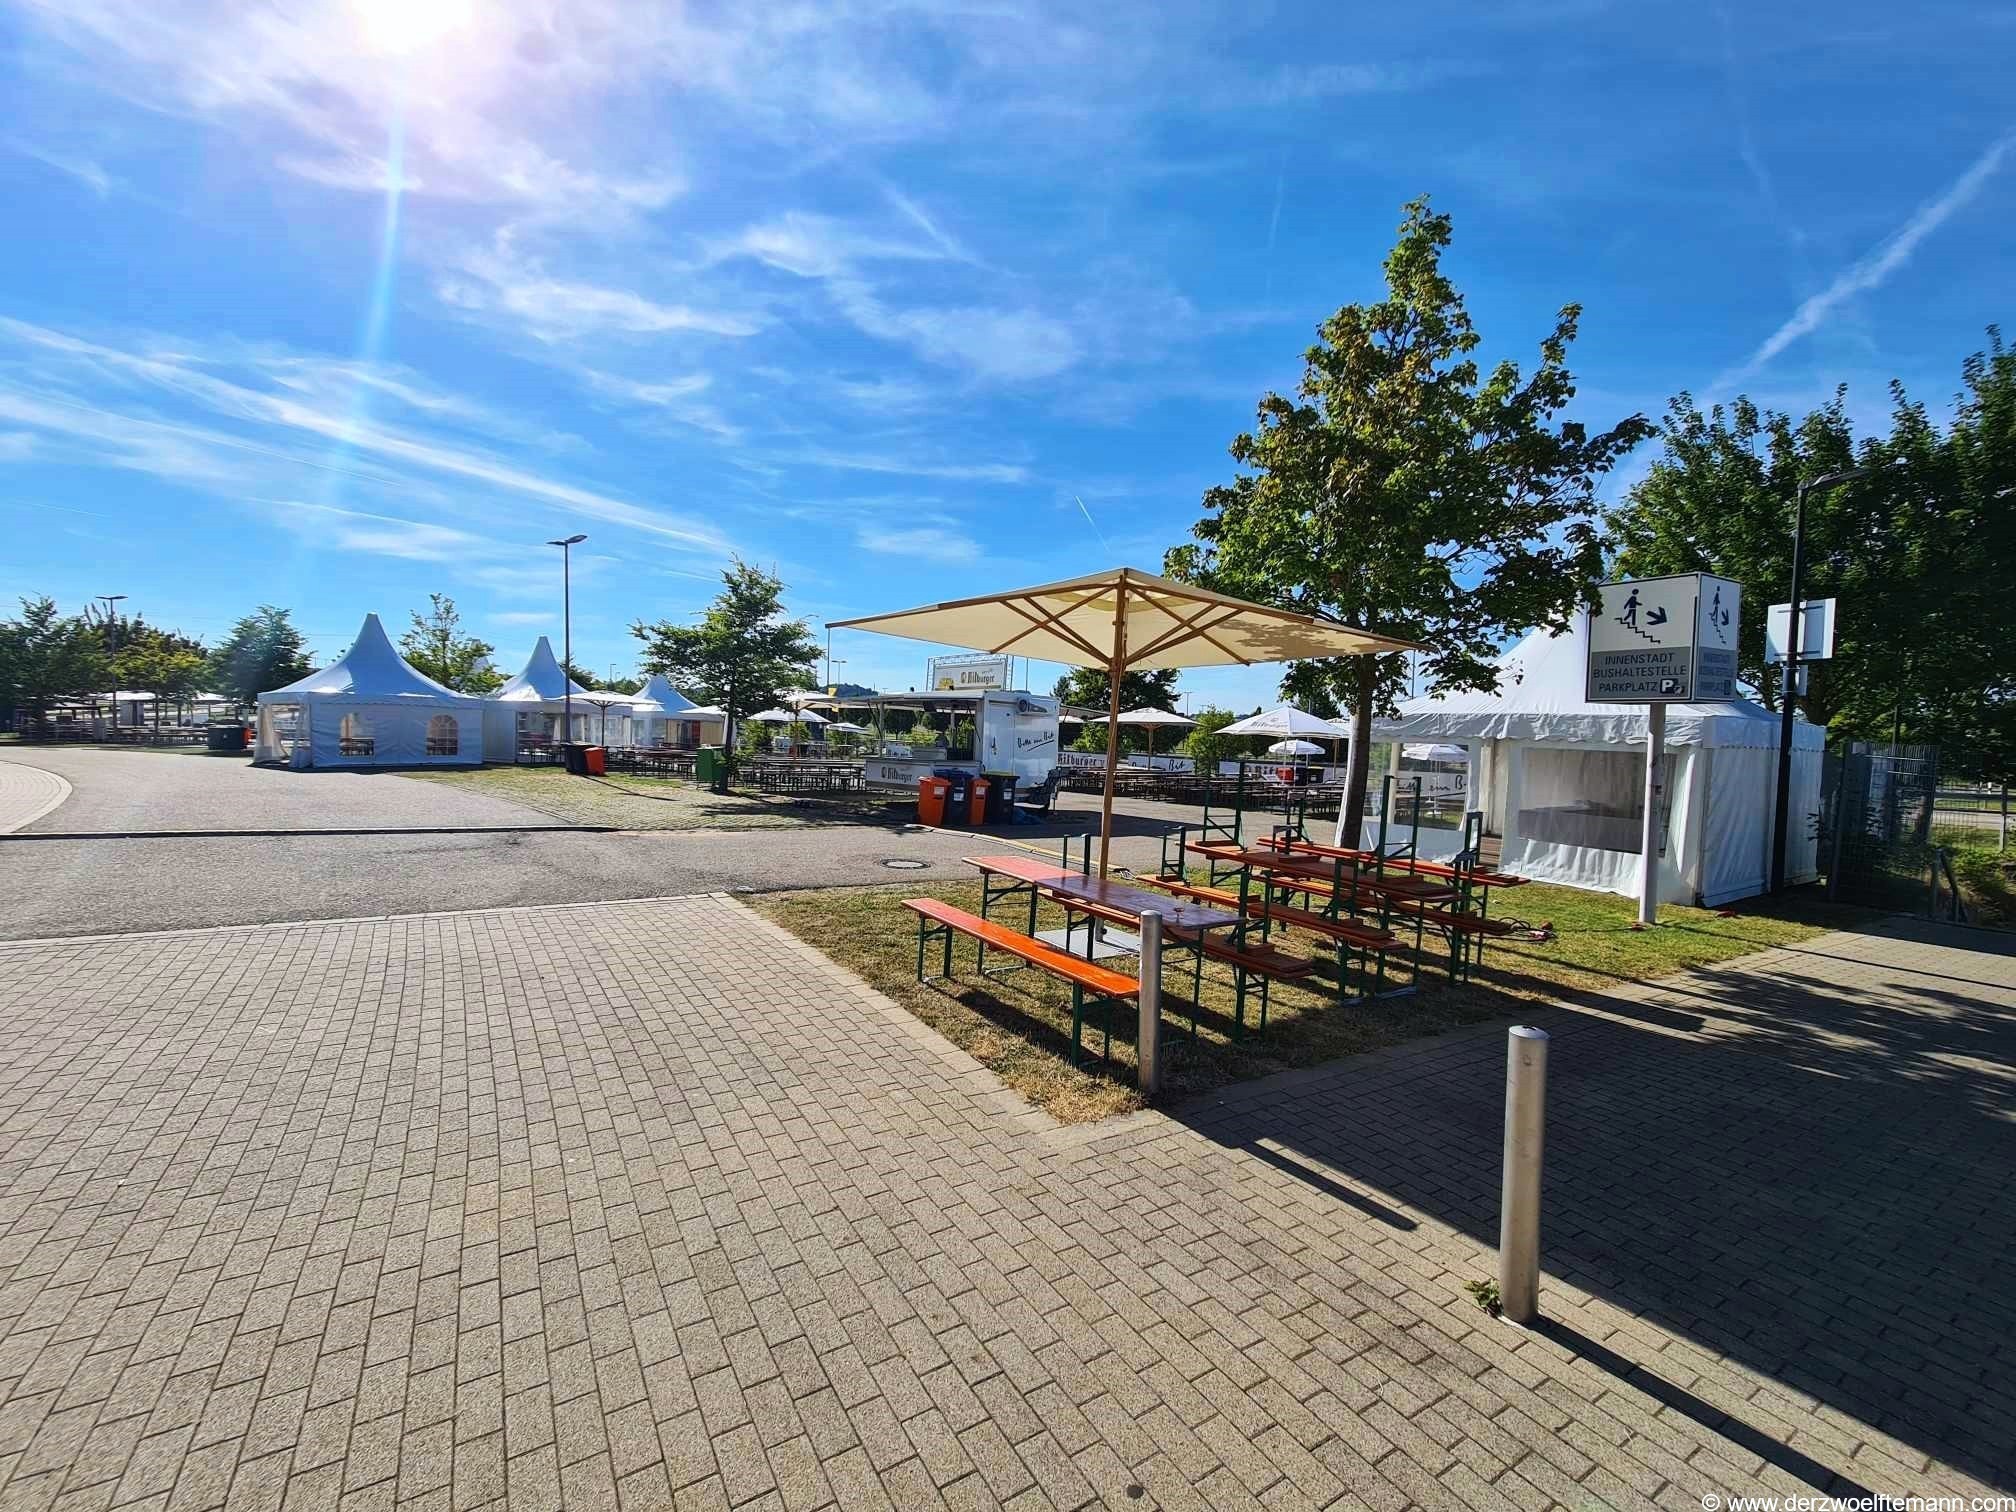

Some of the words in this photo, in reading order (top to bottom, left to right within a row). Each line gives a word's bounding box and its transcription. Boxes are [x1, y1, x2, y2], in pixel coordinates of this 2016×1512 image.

[1605, 653, 1674, 665] INNENSTADT
[1593, 665, 1687, 678] BUSHALTESTELLE
[1599, 681, 1658, 692] PARKPLATZ
[1168, 759, 1184, 771] Bit
